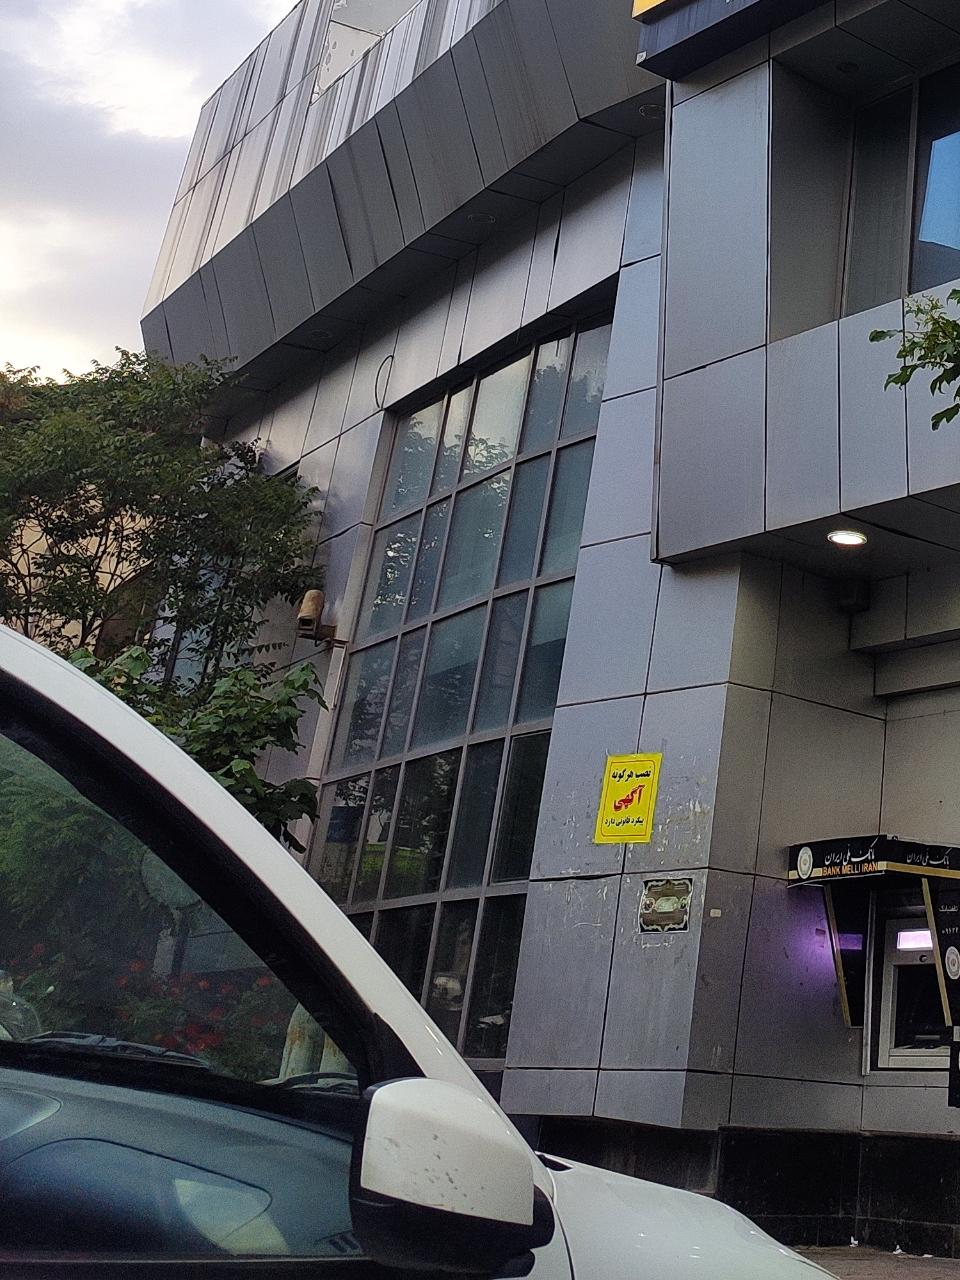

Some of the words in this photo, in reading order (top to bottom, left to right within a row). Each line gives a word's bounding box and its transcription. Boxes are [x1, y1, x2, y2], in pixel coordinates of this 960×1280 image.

[635, 766, 652, 781] نصب
[613, 784, 646, 812] آگهی
[822, 865, 841, 877] BANK
[841, 863, 861, 875] MELLI
[861, 861, 879, 873] IRAN
